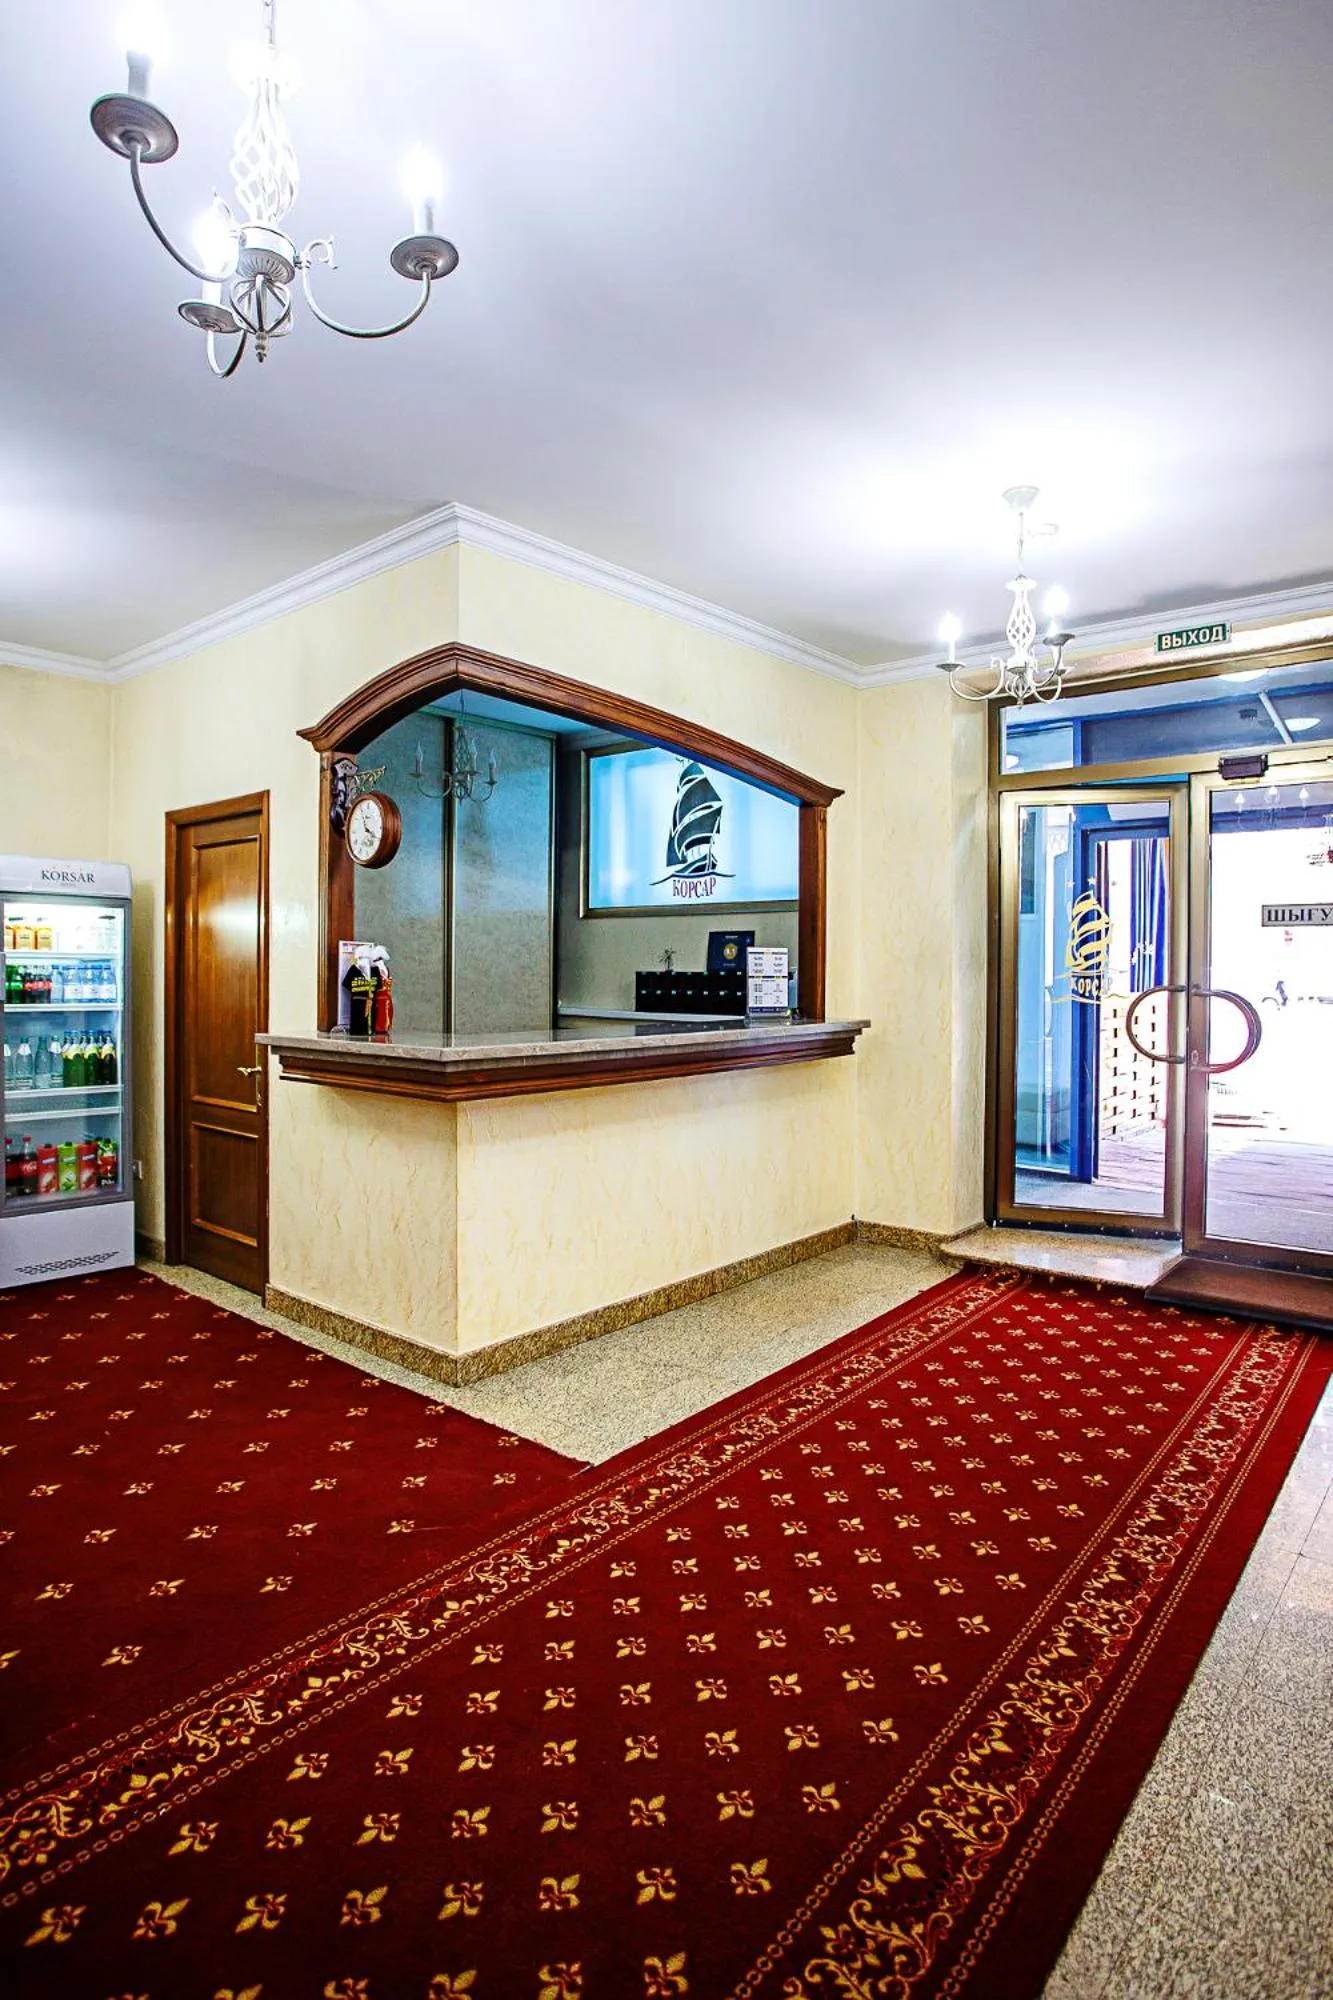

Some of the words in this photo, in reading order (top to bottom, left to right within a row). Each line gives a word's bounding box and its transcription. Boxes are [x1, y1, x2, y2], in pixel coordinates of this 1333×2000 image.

[1161, 626, 1223, 649] ВЫХОД
[41, 870, 96, 883] KORSAR
[672, 877, 717, 898] КОРСАР
[1267, 907, 1333, 922] ШЫГУ
